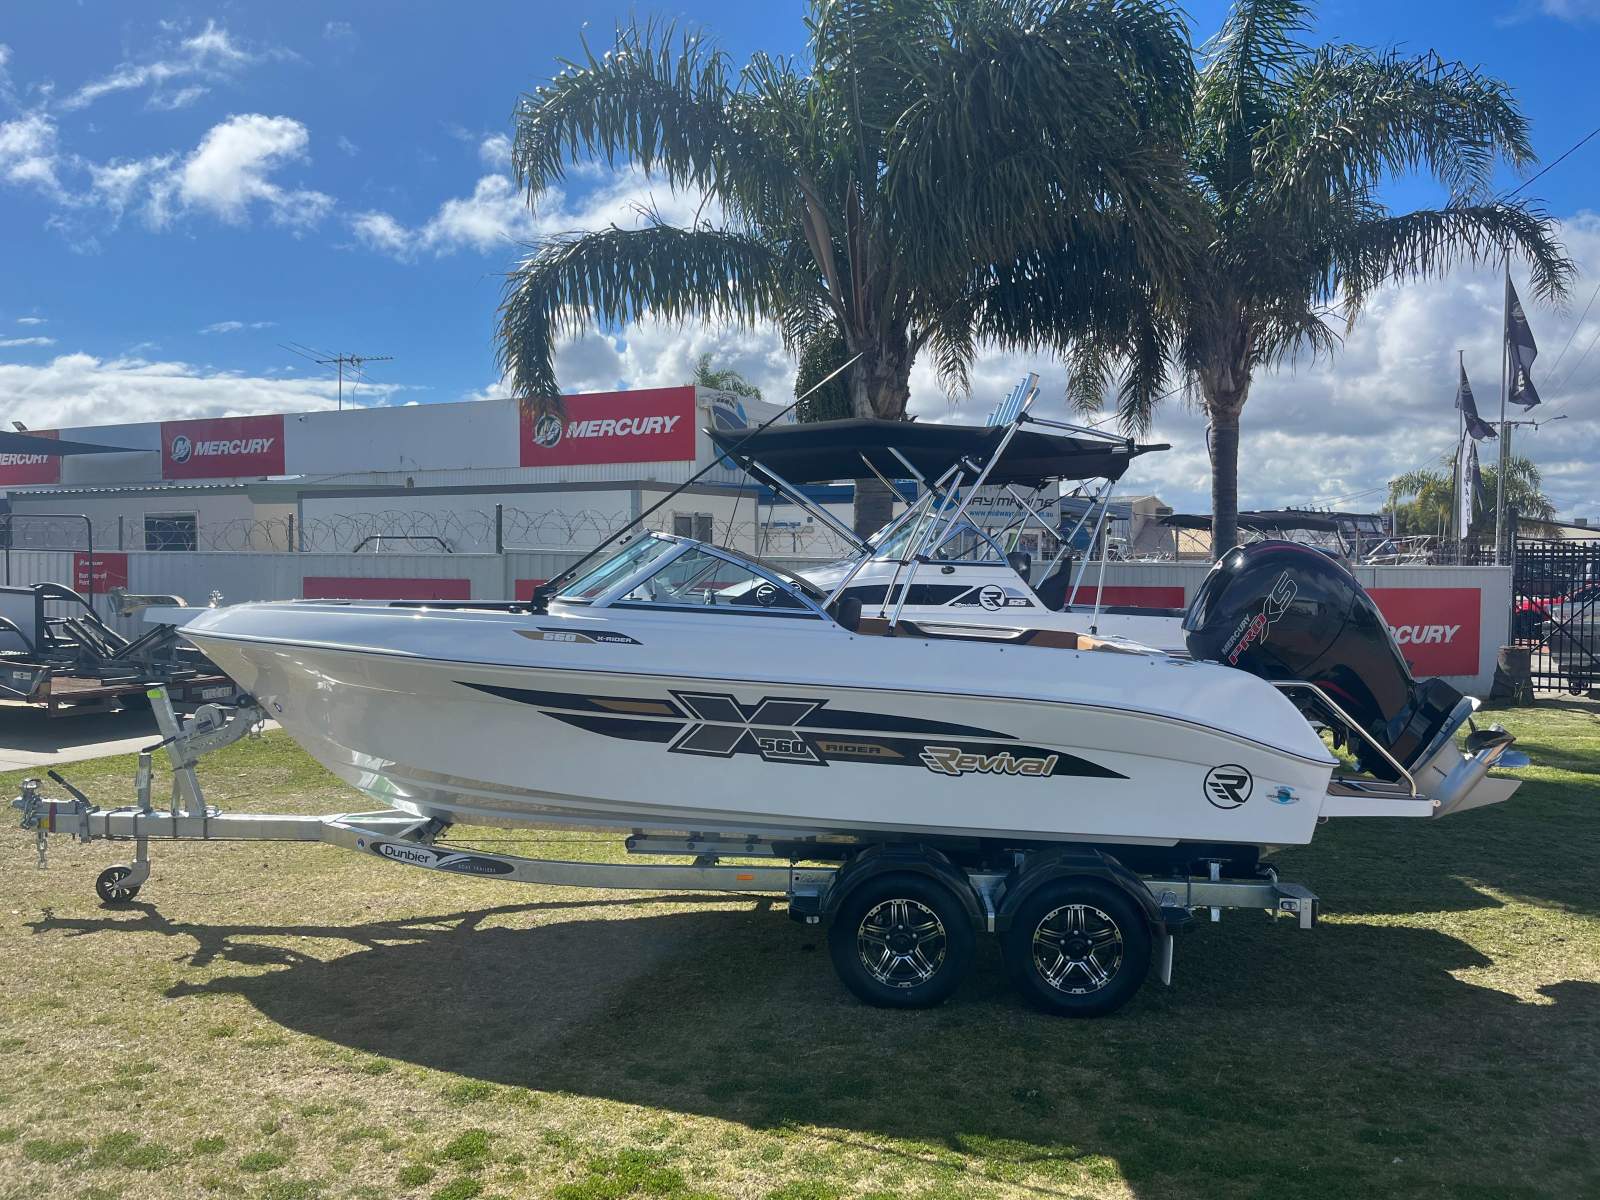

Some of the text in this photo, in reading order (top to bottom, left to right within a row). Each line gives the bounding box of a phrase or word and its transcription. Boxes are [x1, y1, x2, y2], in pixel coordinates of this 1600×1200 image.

[566, 415, 681, 439] MERCURY
[194, 438, 274, 456] MERCURY
[0, 453, 49, 466] ERCURY
[1221, 613, 1252, 655] MERCURY
[1387, 624, 1461, 645] CURY
[757, 737, 881, 755] 560 RIDER
[918, 745, 1059, 776] Revival
[384, 845, 431, 864] Dunbier
